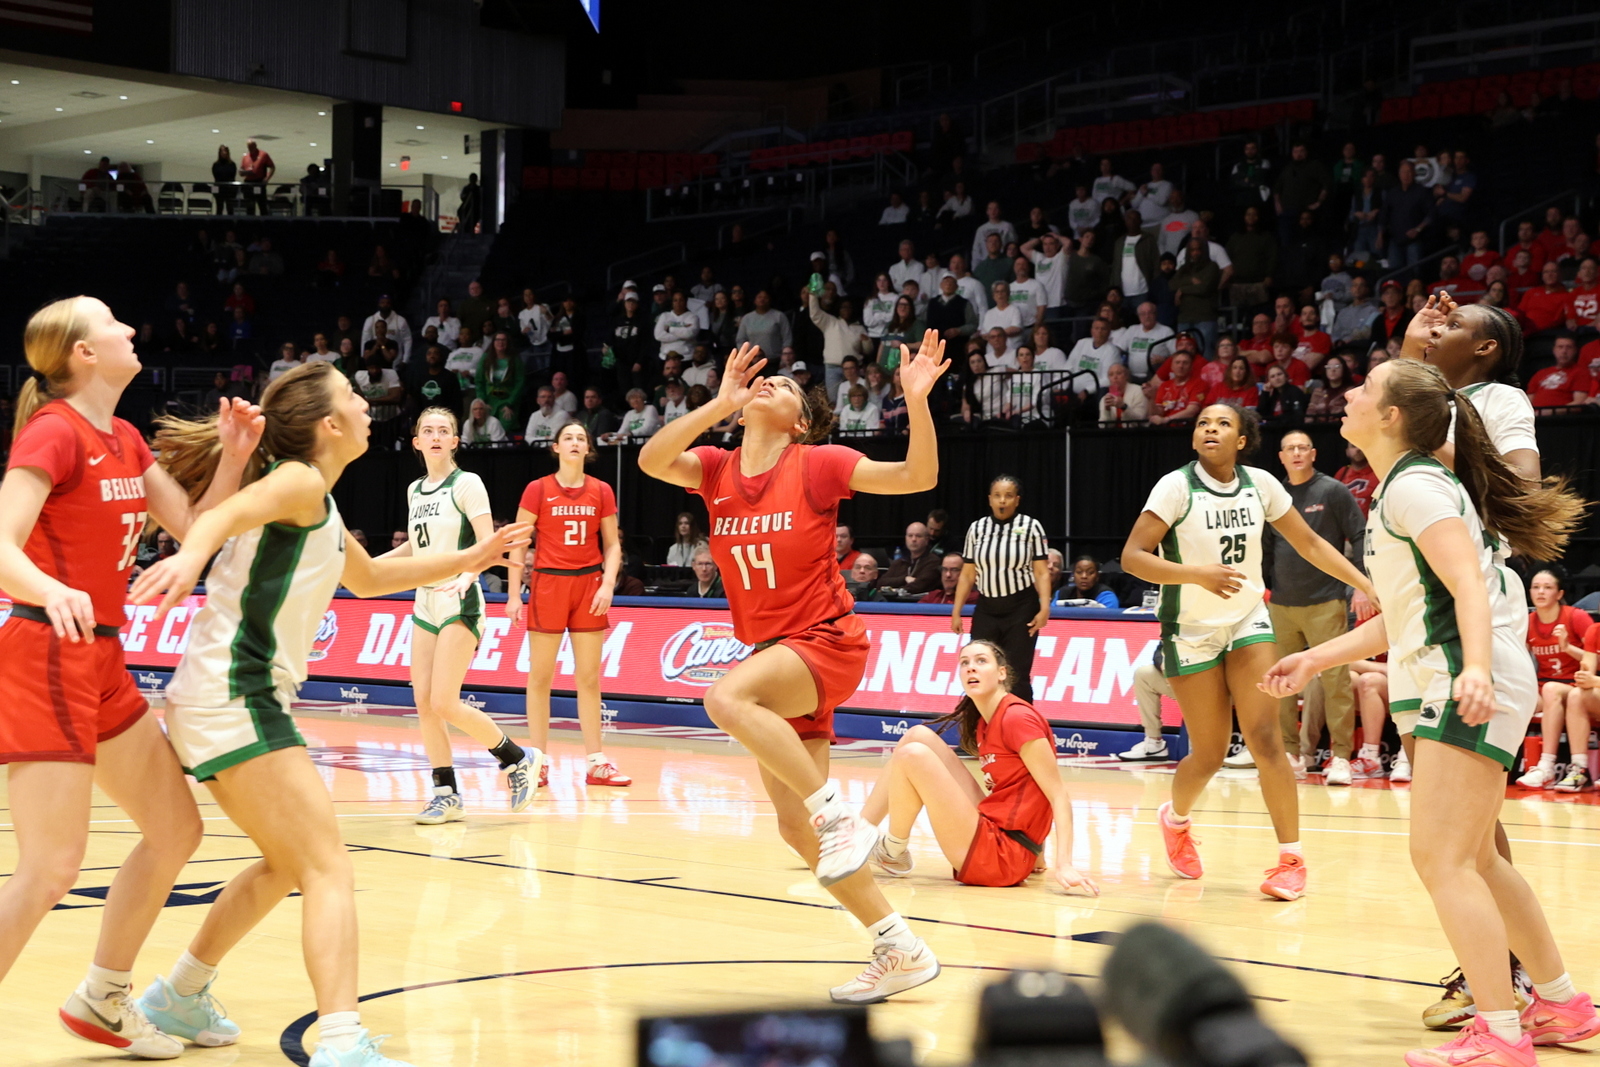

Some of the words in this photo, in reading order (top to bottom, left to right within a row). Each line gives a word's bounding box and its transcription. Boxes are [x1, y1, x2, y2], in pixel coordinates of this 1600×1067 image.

[409, 502, 440, 521] LAUREL
[551, 505, 596, 516] BELLEVUE
[1205, 507, 1256, 530] LAUREL
[414, 522, 430, 548] 21
[564, 520, 587, 545] 21
[713, 511, 793, 536] BELLEVUE
[1219, 533, 1247, 565] 25
[730, 543, 777, 590] 14
[1548, 658, 1562, 676] 3
[1066, 733, 1098, 756] Kroger
